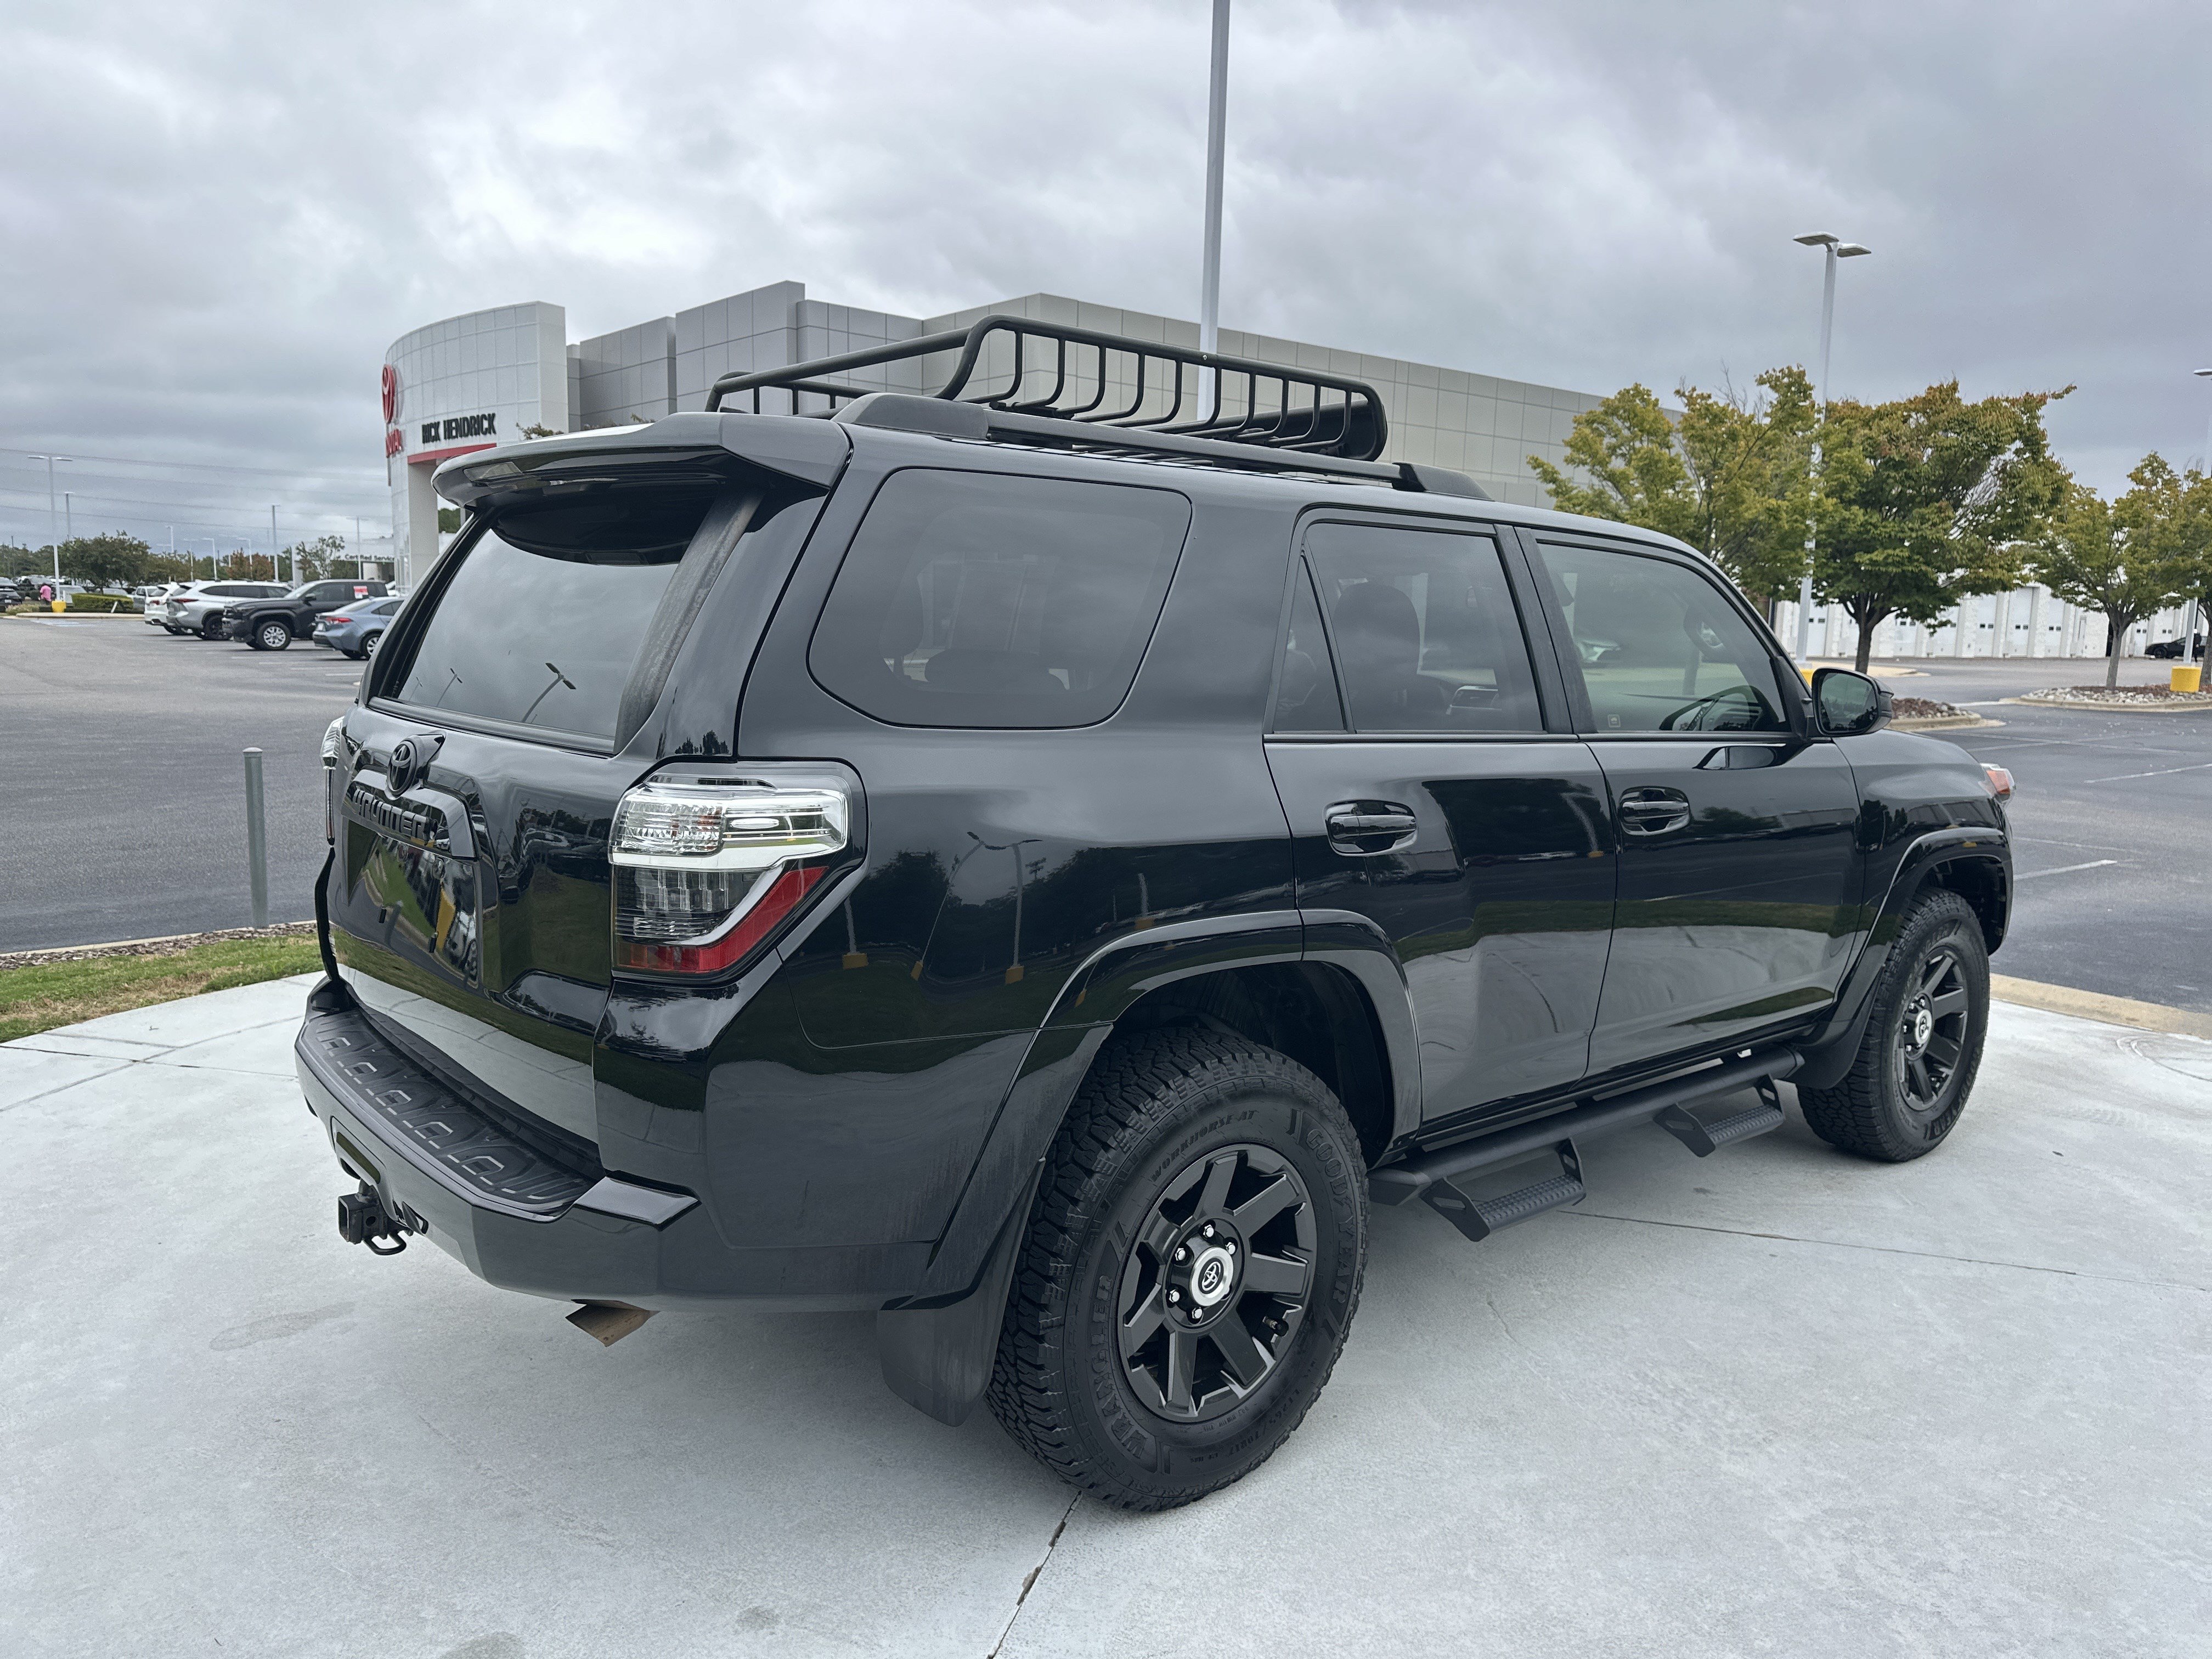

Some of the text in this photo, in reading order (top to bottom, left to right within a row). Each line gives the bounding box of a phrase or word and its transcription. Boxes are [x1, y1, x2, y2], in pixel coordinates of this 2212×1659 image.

[421, 413, 497, 443] RICK HENDRICK
[352, 788, 428, 841] 4RUNNER
[1150, 1110, 1260, 1182] WORKHORSE AT
[1306, 1128, 1356, 1304] GOODYEAR
[1091, 1275, 1148, 1459] WRANGLER
